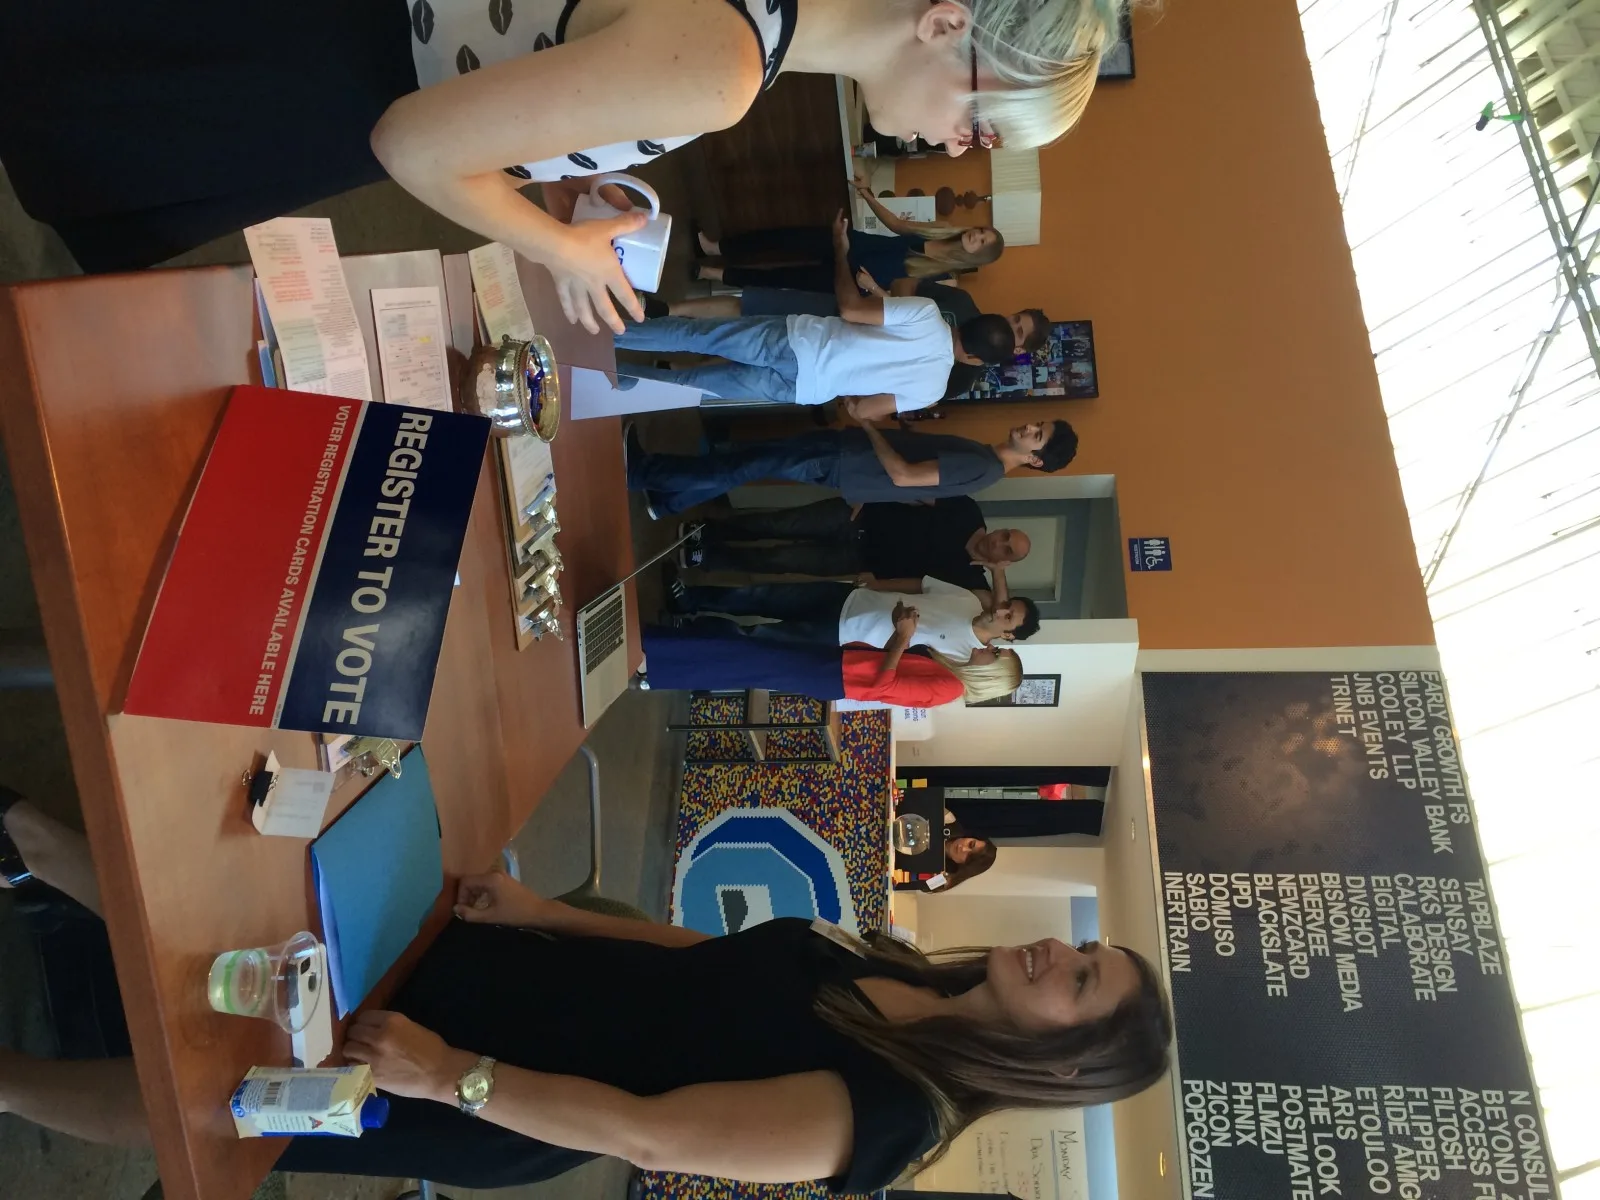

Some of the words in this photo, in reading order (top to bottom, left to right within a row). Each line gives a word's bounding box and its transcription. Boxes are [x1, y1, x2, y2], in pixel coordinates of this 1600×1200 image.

[328, 406, 351, 442] VOTER
[300, 444, 338, 534] REGISTRATION
[363, 412, 434, 558] REGISTER
[286, 537, 310, 585] CARDS
[350, 566, 394, 614] TO
[260, 588, 294, 670] AVAILABLE
[249, 674, 272, 716] HERE
[322, 624, 380, 725] VOTE
[1330, 675, 1356, 738] TRINET
[1352, 672, 1375, 705] JNB
[1398, 672, 1427, 730] SILICON
[1420, 672, 1448, 721] EARLY
[1359, 710, 1389, 780] EVENTS
[1376, 672, 1407, 744] COOLEY
[1392, 754, 1416, 790] LLP
[1432, 726, 1464, 796] GROWTH
[1411, 739, 1442, 800] VALLEY
[1424, 805, 1453, 854] BANK
[1448, 804, 1470, 824] FS
[1164, 872, 1191, 972] INERTRAIN
[1186, 873, 1210, 931] SABIO
[1208, 874, 1236, 956] DOMUSO
[1230, 873, 1252, 908] UPD
[1298, 874, 1330, 957] ENERVEE
[1320, 872, 1353, 946] BISNOW
[1346, 876, 1378, 958] DIVSHOT
[1370, 876, 1401, 950] EIGITAL
[1416, 876, 1442, 914] RKS
[1439, 878, 1473, 956] SENSAY
[1253, 874, 1288, 997] BLACKSLATE
[1276, 874, 1310, 979] NEWZCARD
[1394, 874, 1436, 1001] CALABORATE
[1424, 924, 1458, 992] DESIGN
[1464, 878, 1502, 975] TAPBLAZE
[1336, 954, 1363, 1012] MEDIA
[1206, 1080, 1232, 1147] ZICON
[1232, 1082, 1258, 1146] PHNIX
[1255, 1082, 1284, 1154] FILMZU
[1306, 1085, 1332, 1124] THE
[1330, 1086, 1358, 1140] ARIS
[1382, 1085, 1410, 1135] RIDE
[1431, 1087, 1467, 1170] FILTOSH
[1456, 1087, 1492, 1176] ACCESS
[1508, 1090, 1532, 1106] N
[1183, 1080, 1214, 1198] POPGOZEN
[1280, 1085, 1314, 1200] POSTMATE
[1312, 1132, 1342, 1196] LOOK
[1355, 1087, 1392, 1194] ETOULOO
[1406, 1087, 1440, 1181] FLIPPER
[1482, 1090, 1519, 1184] BEYOND
[1514, 1114, 1551, 1200] CONSUL
[1392, 1143, 1421, 1200] AMIG
